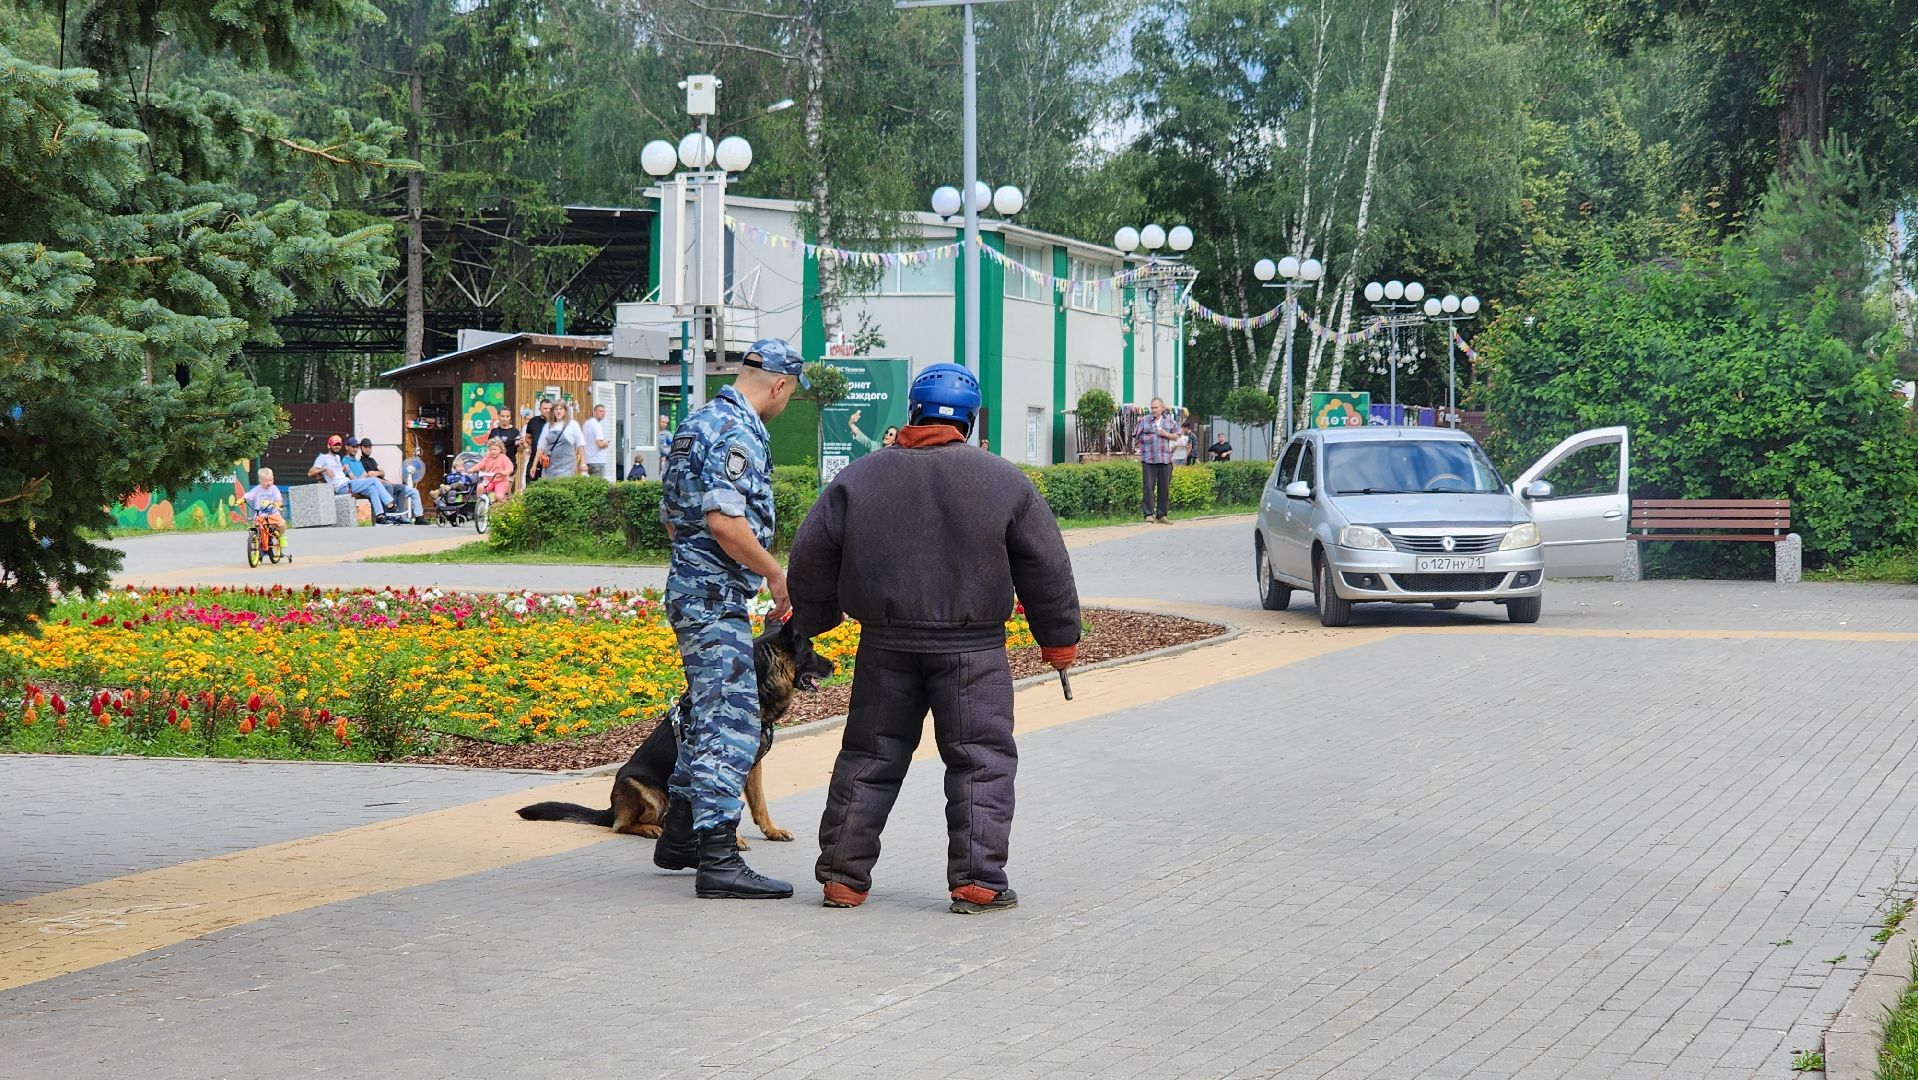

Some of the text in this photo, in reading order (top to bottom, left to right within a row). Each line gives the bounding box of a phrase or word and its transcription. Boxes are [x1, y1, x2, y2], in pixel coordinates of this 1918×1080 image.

[521, 360, 589, 381] МОРОЖЕНОЕ
[1319, 416, 1360, 426] лето
[1469, 557, 1484, 569] 71
